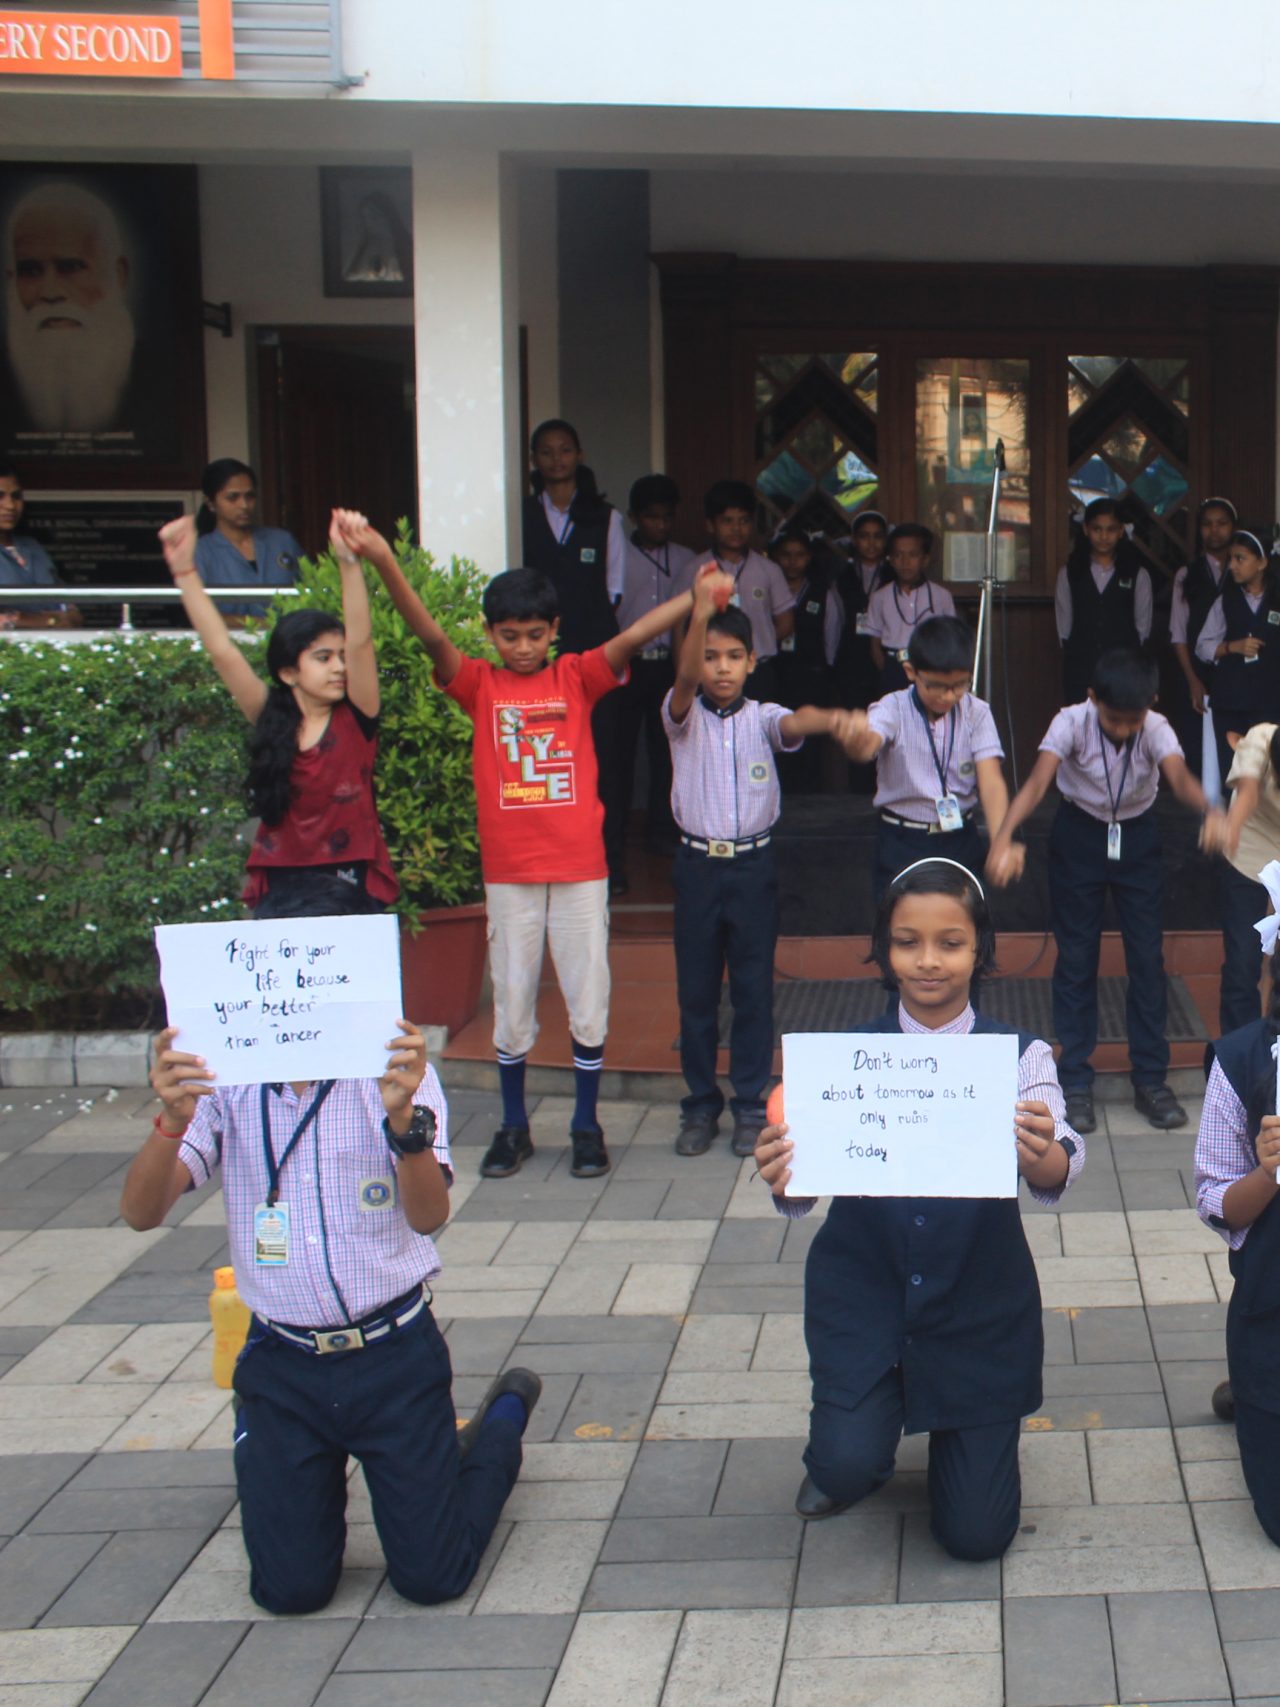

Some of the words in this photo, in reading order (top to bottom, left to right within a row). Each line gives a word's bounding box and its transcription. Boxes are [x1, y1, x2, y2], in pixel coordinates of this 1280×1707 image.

[53, 24, 172, 62] SECOND
[500, 707, 571, 800] STYLE
[225, 938, 270, 971] Fight
[277, 939, 299, 959] for
[306, 945, 336, 965] your
[256, 969, 281, 991] life
[214, 999, 252, 1025] your
[261, 998, 316, 1017] better
[225, 1034, 259, 1049] than
[276, 1029, 322, 1045] cancer
[853, 1049, 893, 1071] Don't
[901, 1055, 938, 1073] worry
[822, 1083, 865, 1101] about
[873, 1083, 935, 1100] tomorrow
[943, 1087, 957, 1099] as
[963, 1083, 977, 1099] it
[860, 1111, 887, 1130] only
[898, 1110, 928, 1124] ruins
[845, 1139, 888, 1163] today
